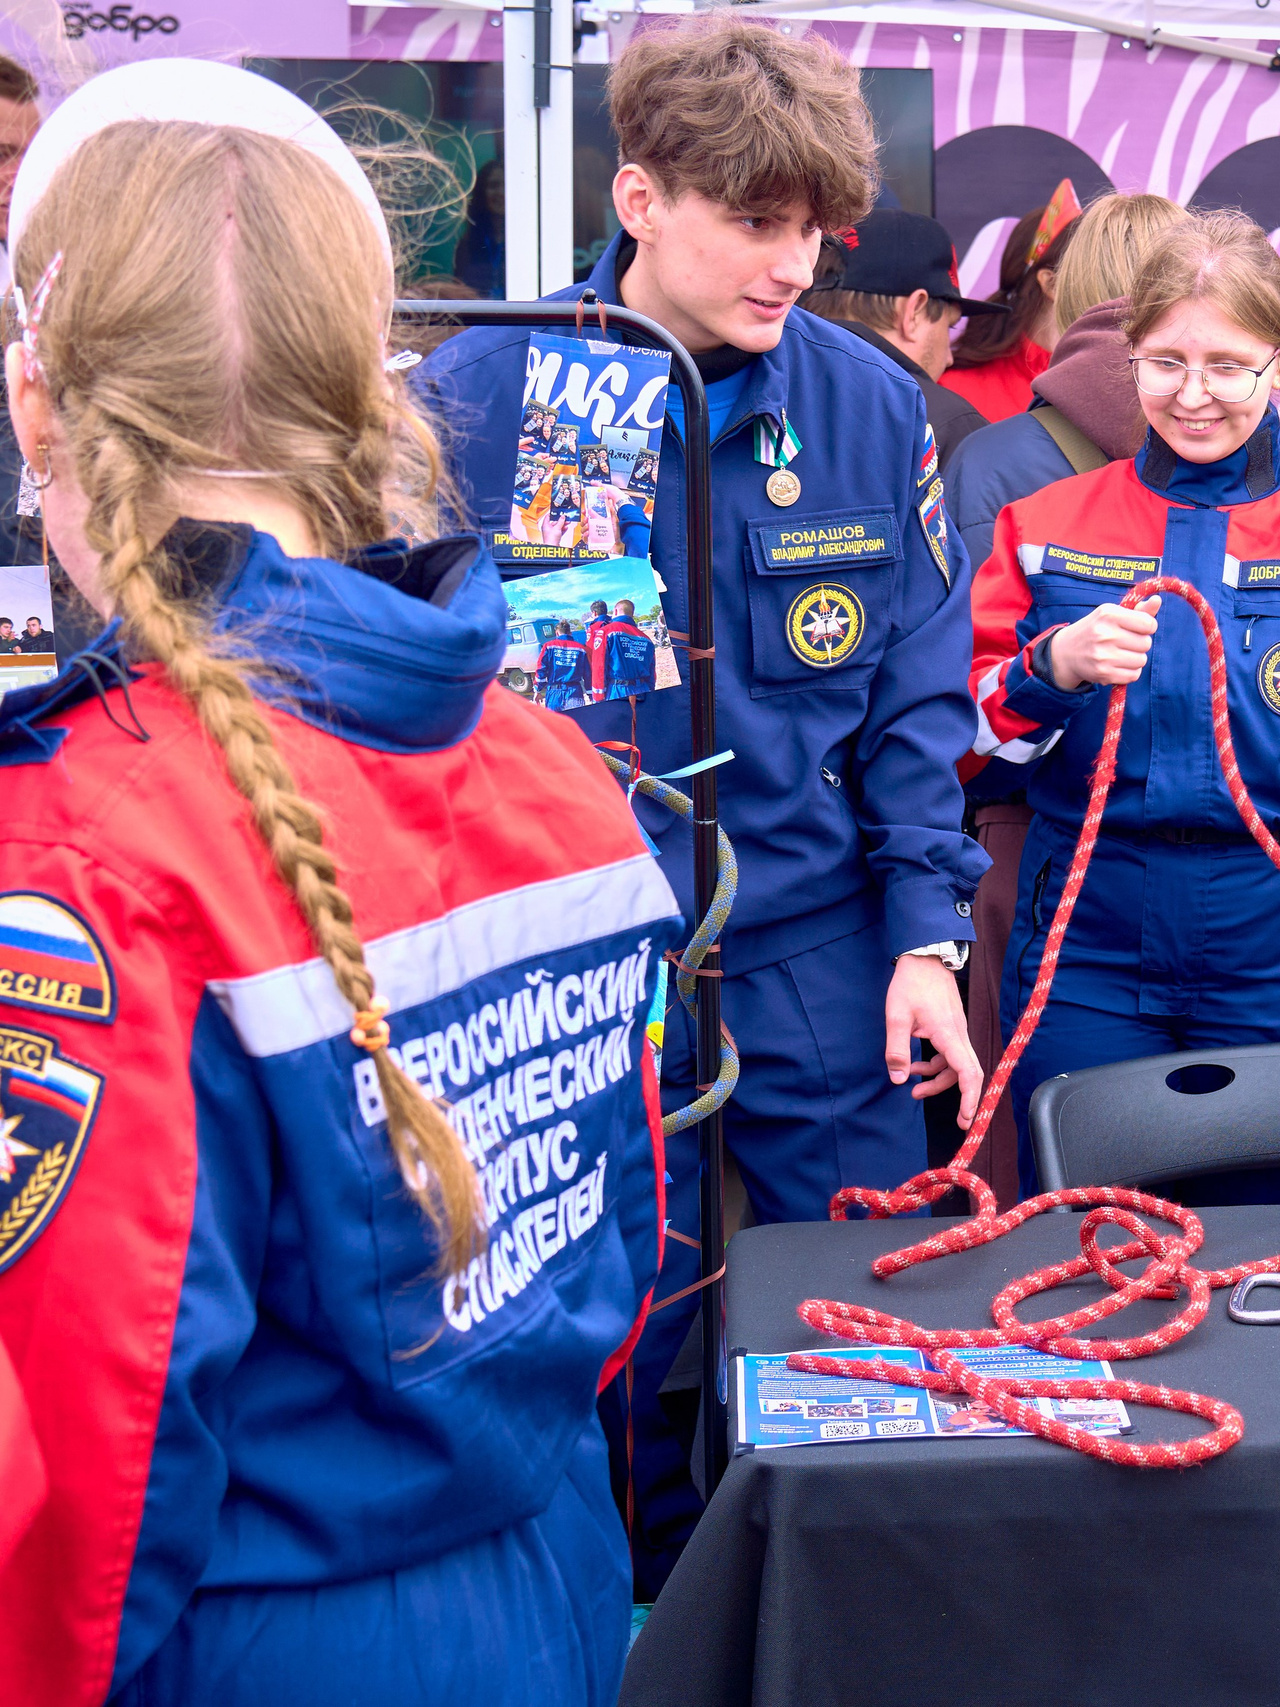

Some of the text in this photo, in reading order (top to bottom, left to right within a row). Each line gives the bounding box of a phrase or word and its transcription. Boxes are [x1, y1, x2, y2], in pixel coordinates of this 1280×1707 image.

[780, 525, 865, 545] РОМАШОВ
[771, 538, 885, 561] ВЛАДИМИР АЛЕКСАНДРОВИЧ
[1048, 547, 1155, 572] ВСЕРОССИЙСКИЙ СТУДЕНЧЕСКИЙ
[1065, 562, 1134, 580] КОРПУС СПАСАТЕЛЕЙ
